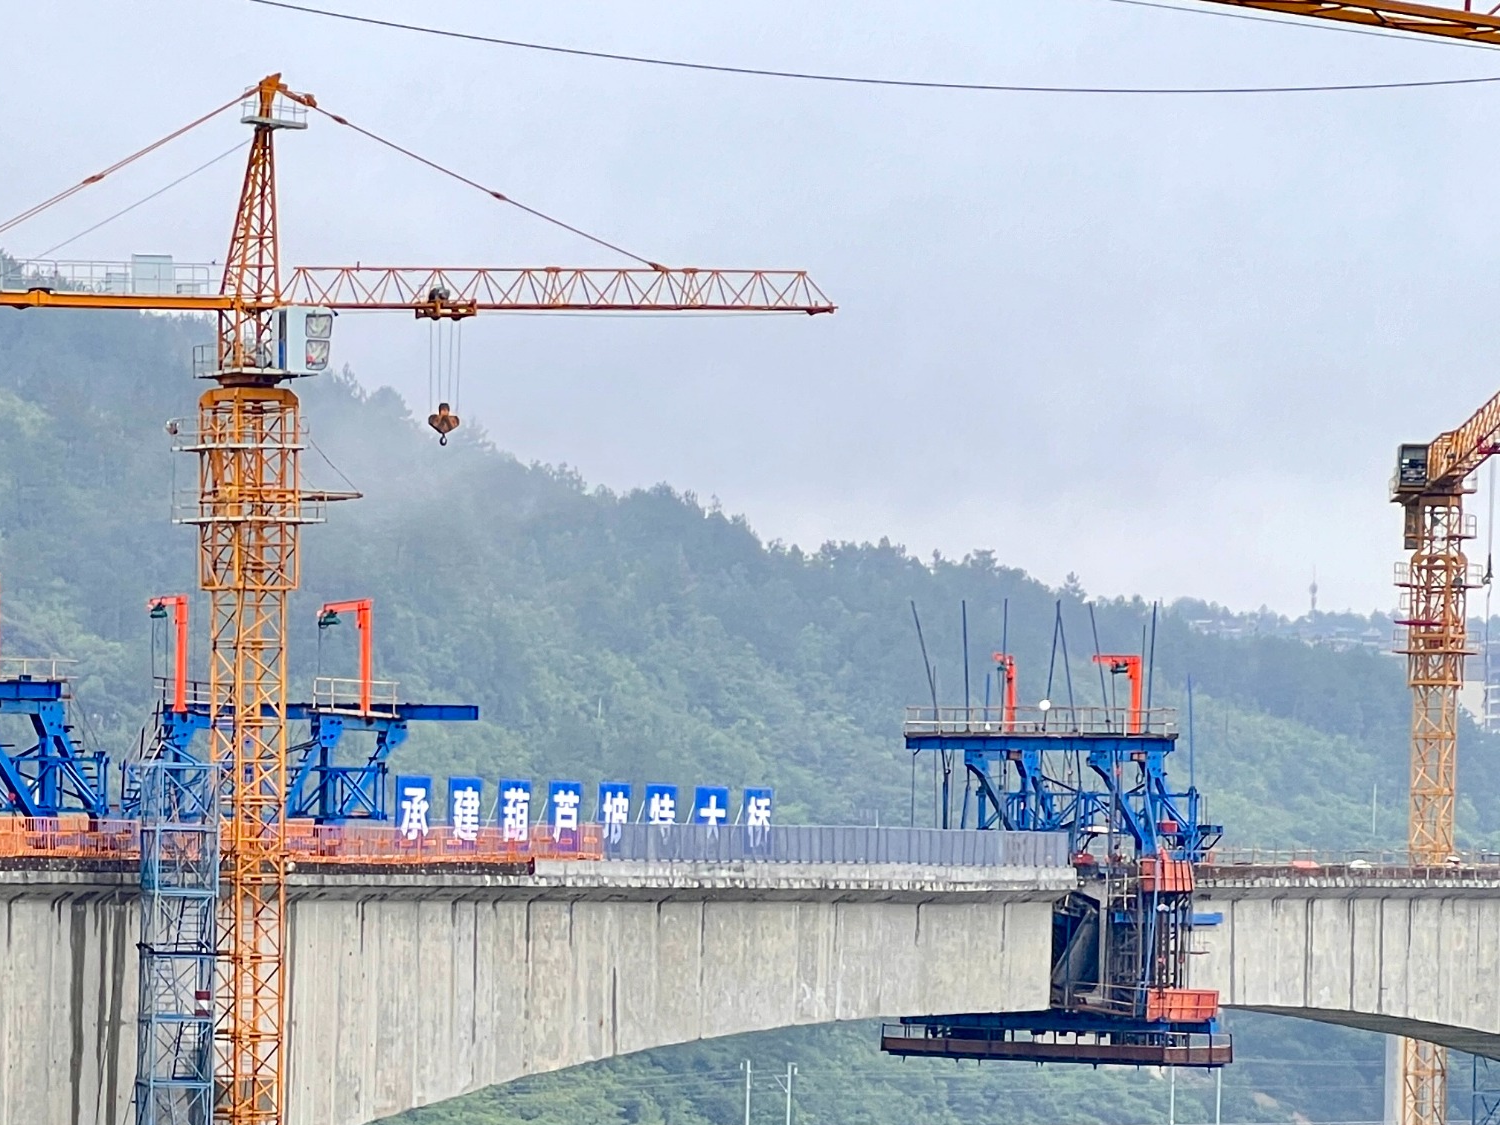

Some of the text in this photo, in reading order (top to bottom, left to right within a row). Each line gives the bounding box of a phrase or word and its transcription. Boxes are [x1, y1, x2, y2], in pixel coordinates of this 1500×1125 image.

[399, 786, 772, 848] 承建葫芦坡特大桥
